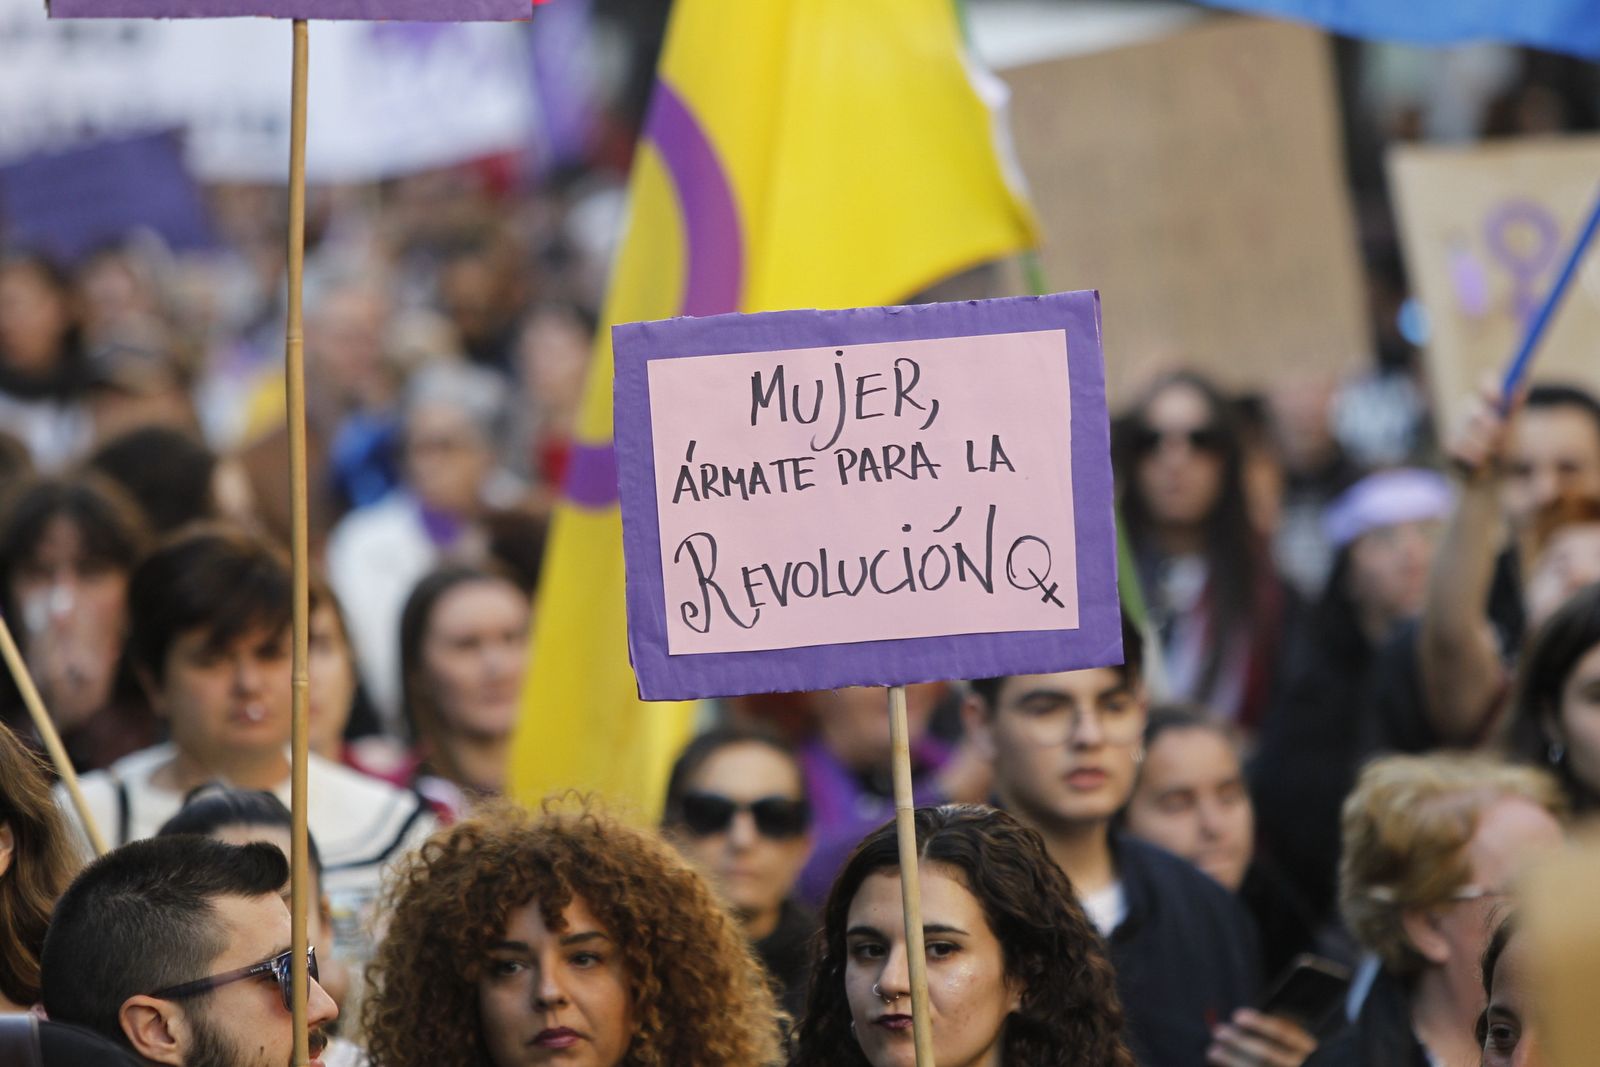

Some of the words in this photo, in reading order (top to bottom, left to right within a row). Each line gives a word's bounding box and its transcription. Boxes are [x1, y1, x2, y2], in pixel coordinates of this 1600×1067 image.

[671, 440, 816, 504] ÁRMATE
[833, 441, 942, 486] PARA
[965, 434, 1016, 473] LA
[673, 504, 997, 634] REVOLUCIÓN
